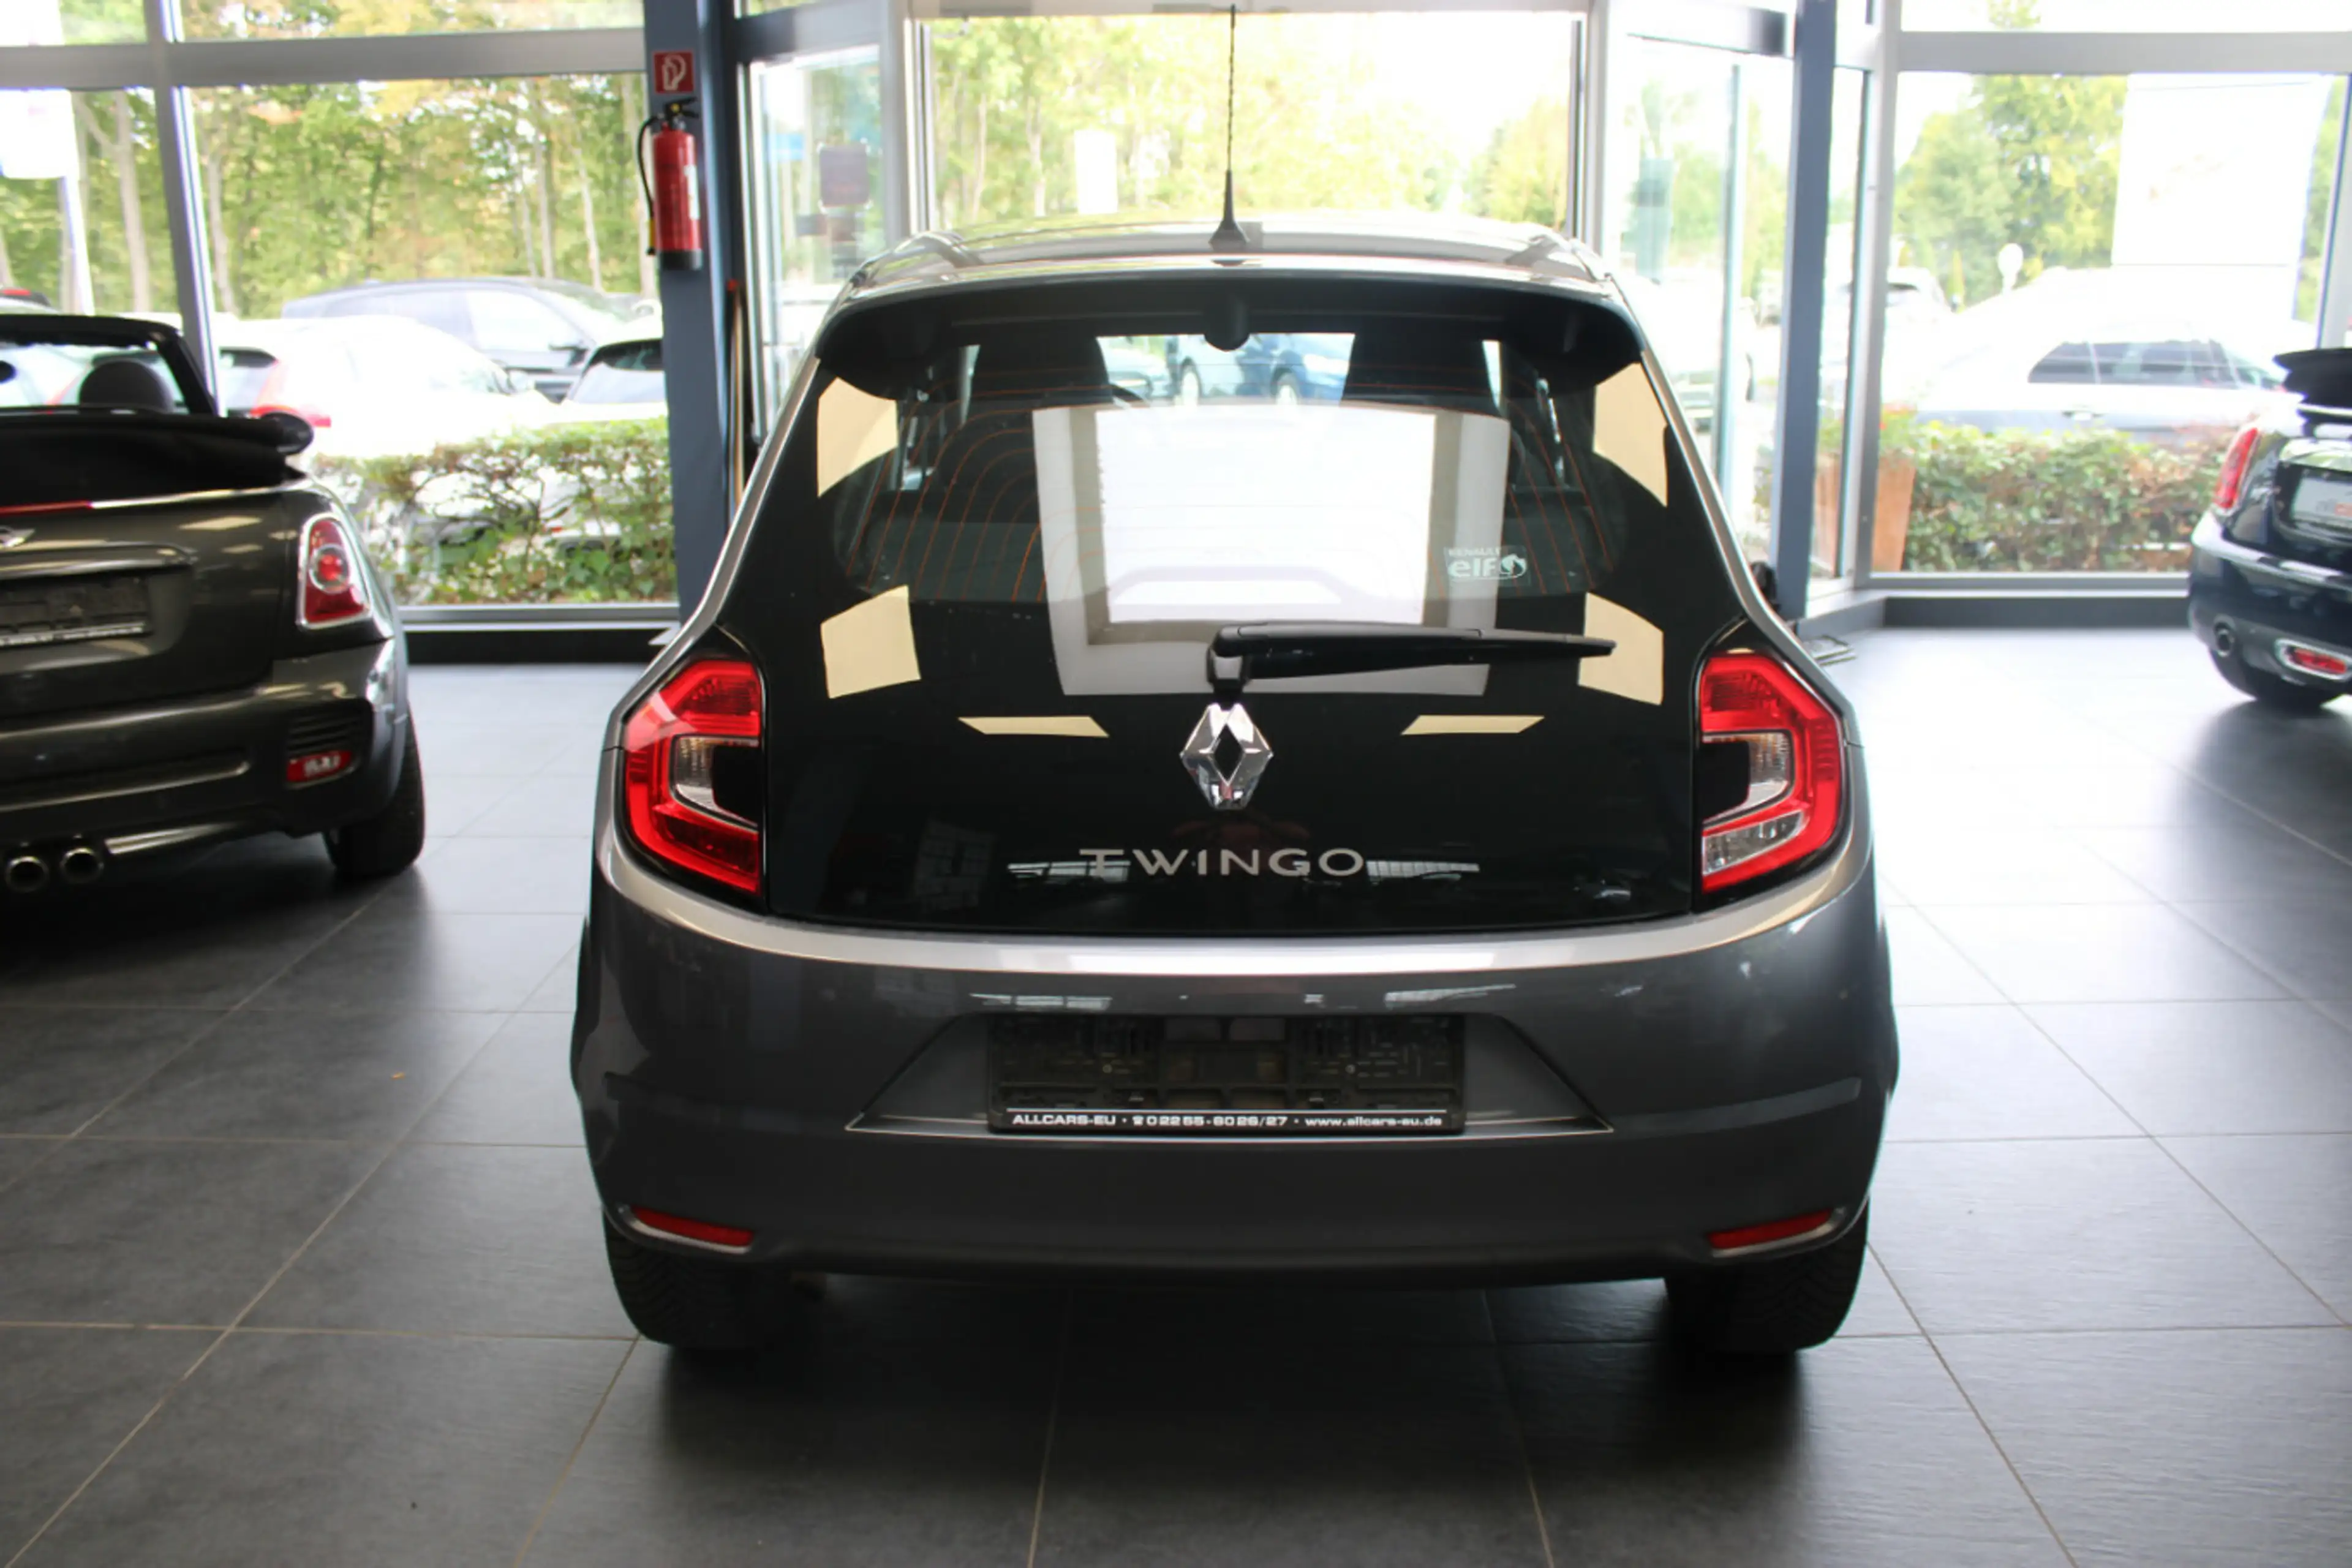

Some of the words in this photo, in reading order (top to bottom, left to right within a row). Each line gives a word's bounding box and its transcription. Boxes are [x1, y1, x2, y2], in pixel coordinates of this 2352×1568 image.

[1079, 848, 1364, 876] TWINGO
[1012, 1115, 1116, 1125] ALLCARS-EU
[1305, 1116, 1442, 1126] www.allcars-eu.de
